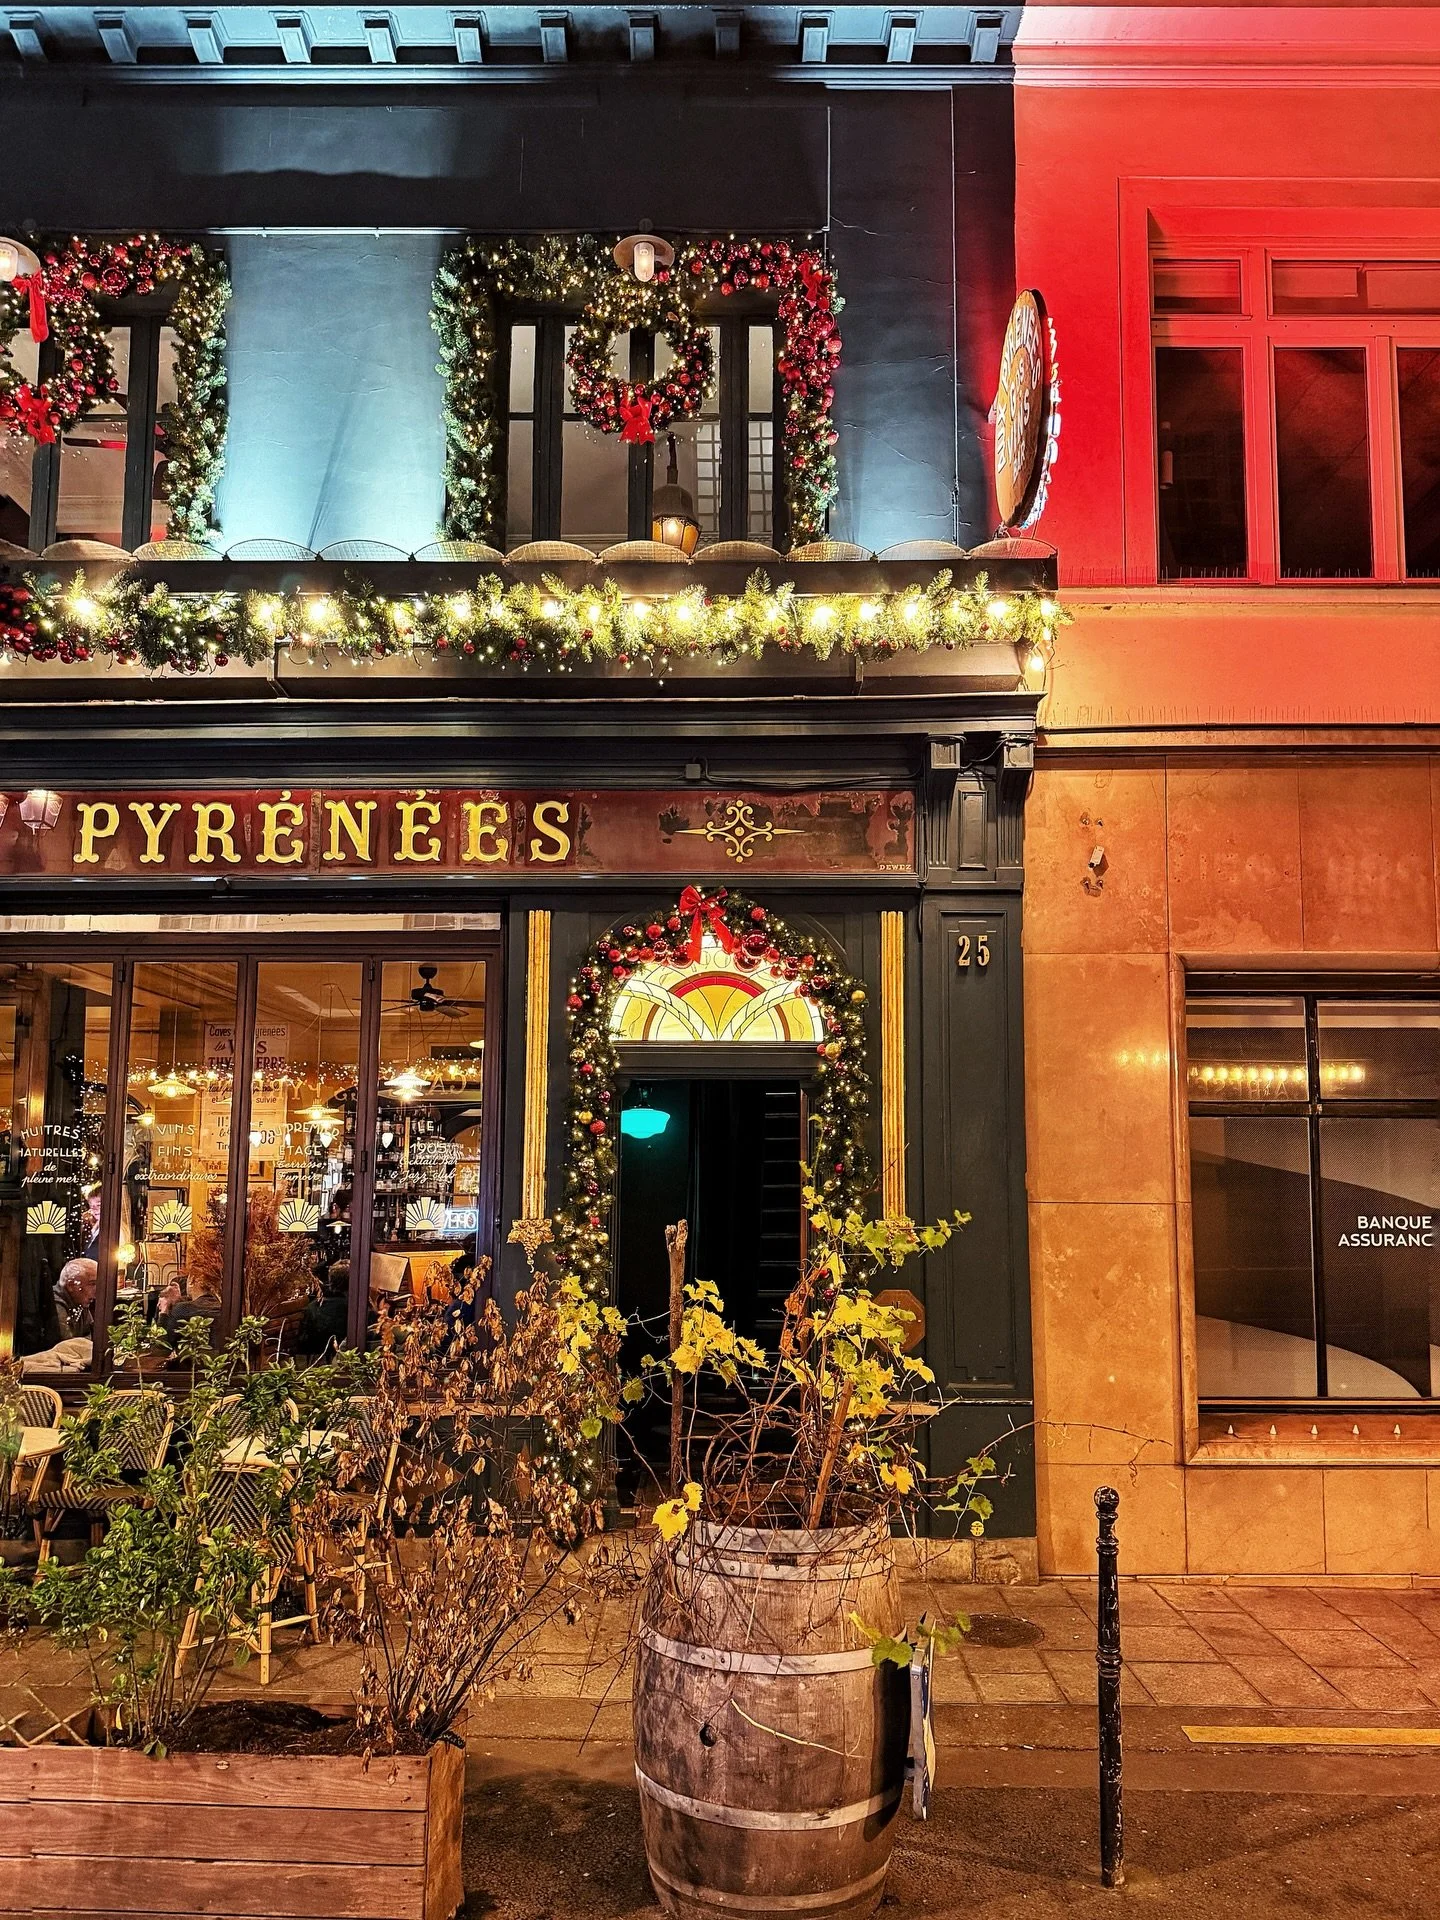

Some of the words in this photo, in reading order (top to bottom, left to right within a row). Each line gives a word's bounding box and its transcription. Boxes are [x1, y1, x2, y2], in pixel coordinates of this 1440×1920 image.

[73, 789, 570, 864] PYRÉNÉES
[958, 935, 990, 966] 25
[209, 1024, 231, 1036] Caves
[21, 1125, 80, 1139] HUITRES
[157, 1124, 196, 1135] VINS
[418, 1121, 434, 1132] LE
[158, 1146, 193, 1157] FINS
[410, 1142, 446, 1154] 1905
[44, 1161, 57, 1171] de
[21, 1172, 53, 1188] pleine
[55, 1174, 78, 1183] mer
[134, 1168, 217, 1181] extraordinaires
[391, 1170, 398, 1178] &
[400, 1169, 429, 1183] Jazz
[1357, 1216, 1432, 1230] BANQUE
